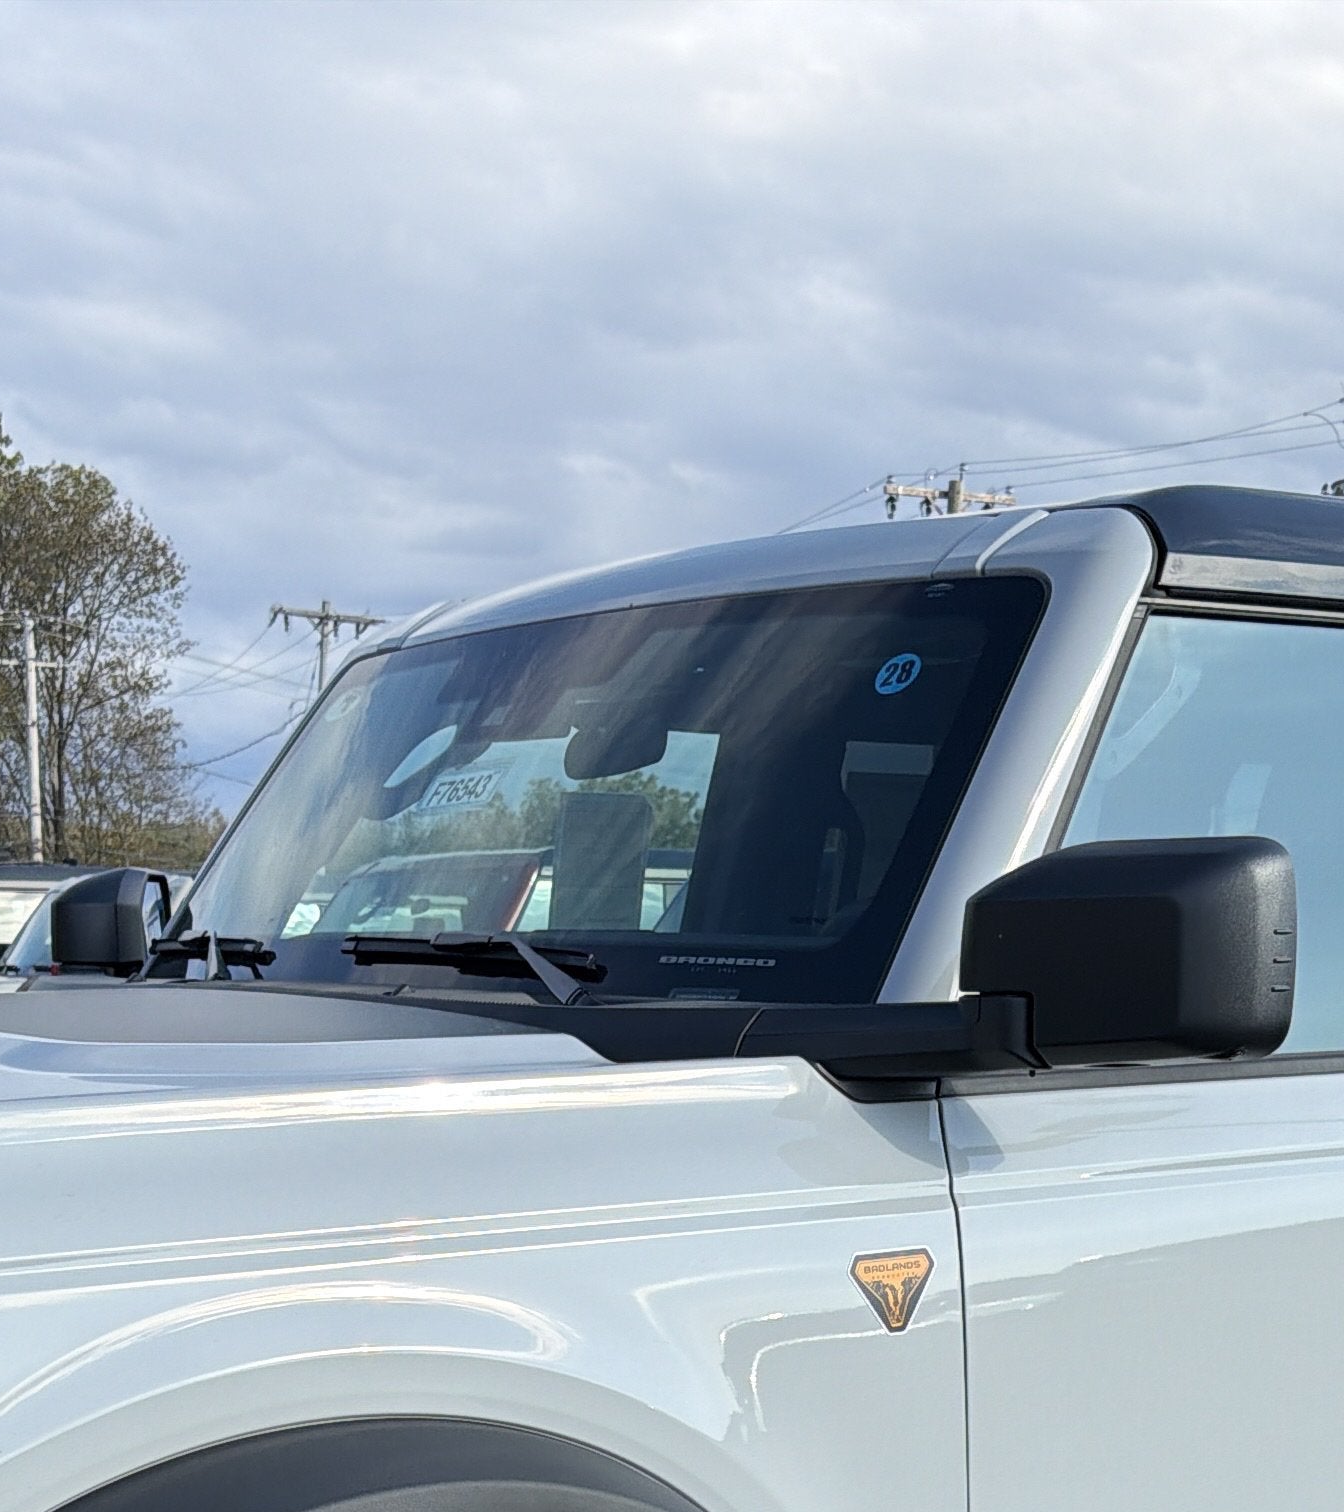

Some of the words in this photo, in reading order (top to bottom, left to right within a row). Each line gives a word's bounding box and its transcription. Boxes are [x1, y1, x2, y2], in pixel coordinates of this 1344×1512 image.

[878, 659, 917, 689] 28
[426, 774, 494, 807] F76543
[658, 955, 776, 967] BRONCO
[863, 1260, 921, 1274] BADLANDS
